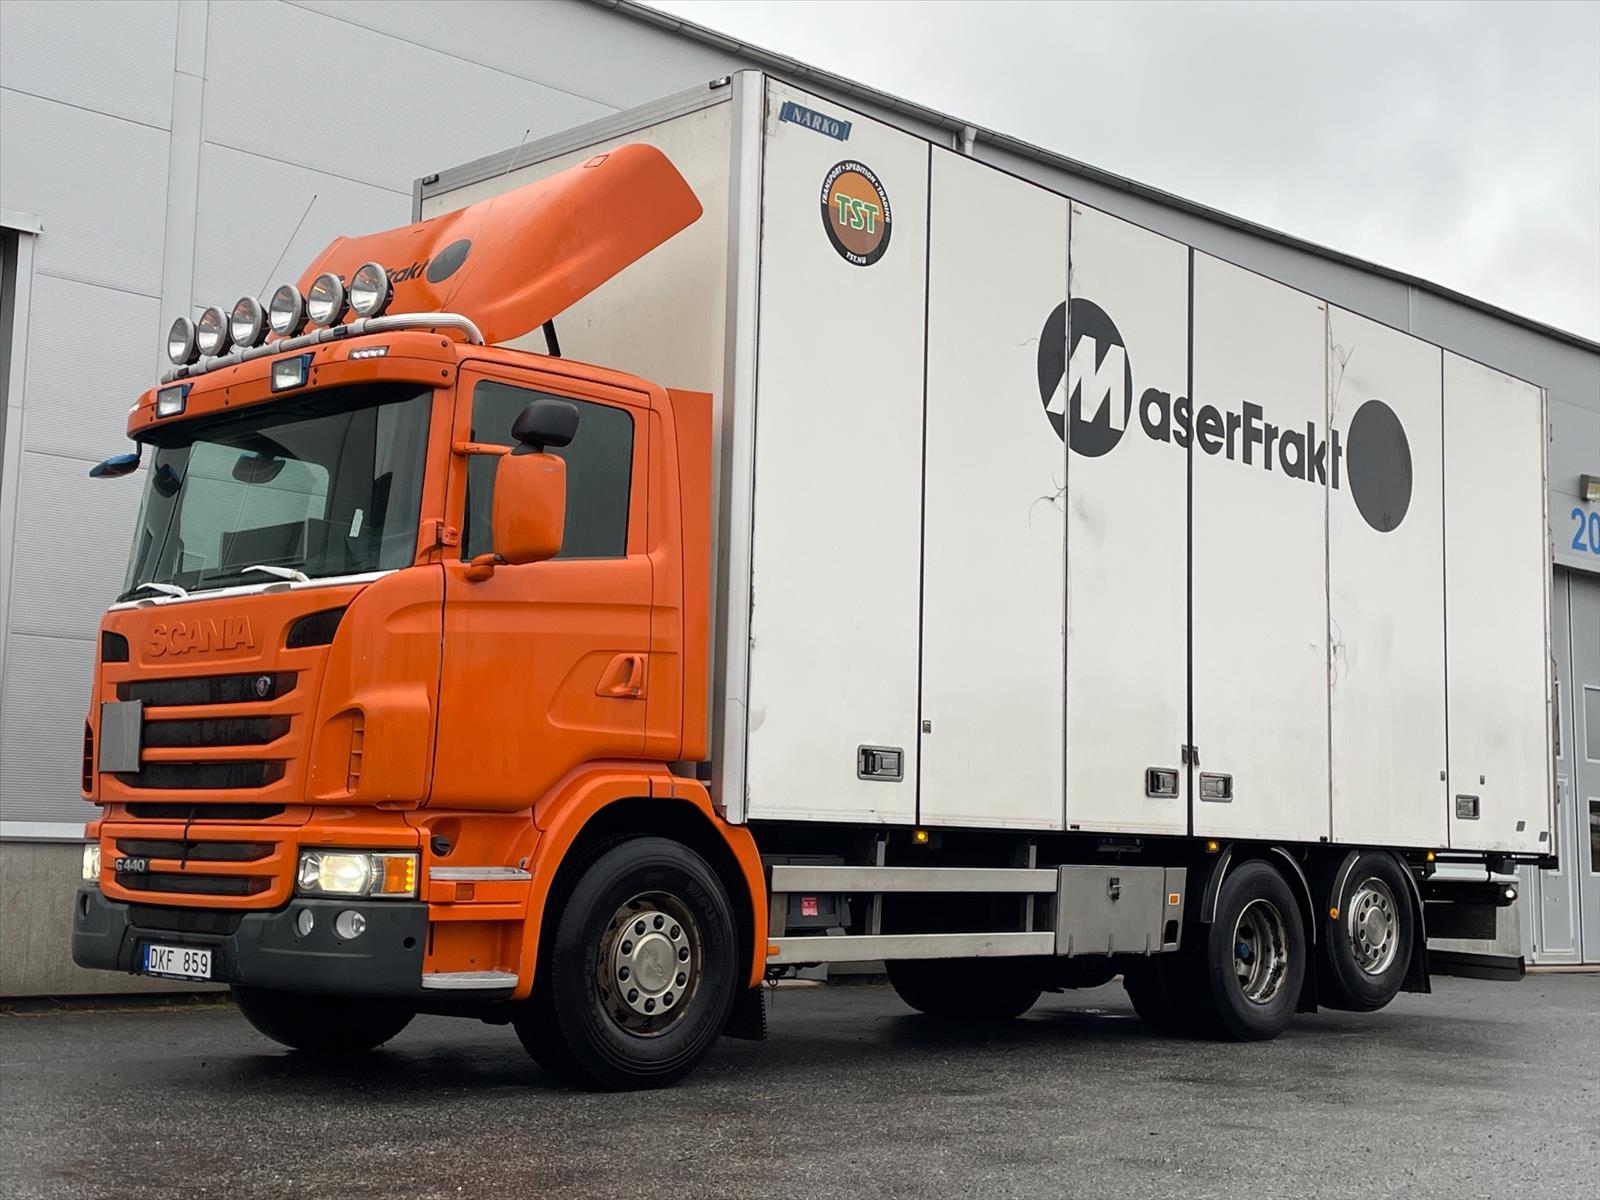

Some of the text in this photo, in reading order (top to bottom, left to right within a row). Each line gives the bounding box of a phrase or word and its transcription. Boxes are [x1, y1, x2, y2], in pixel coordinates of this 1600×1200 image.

[822, 163, 891, 223] TRANSPORT SPEDITION TRADING
[835, 192, 879, 234] TST
[149, 615, 255, 657] SCANIA
[115, 859, 146, 872] G 440
[150, 948, 208, 974] DKF 859
